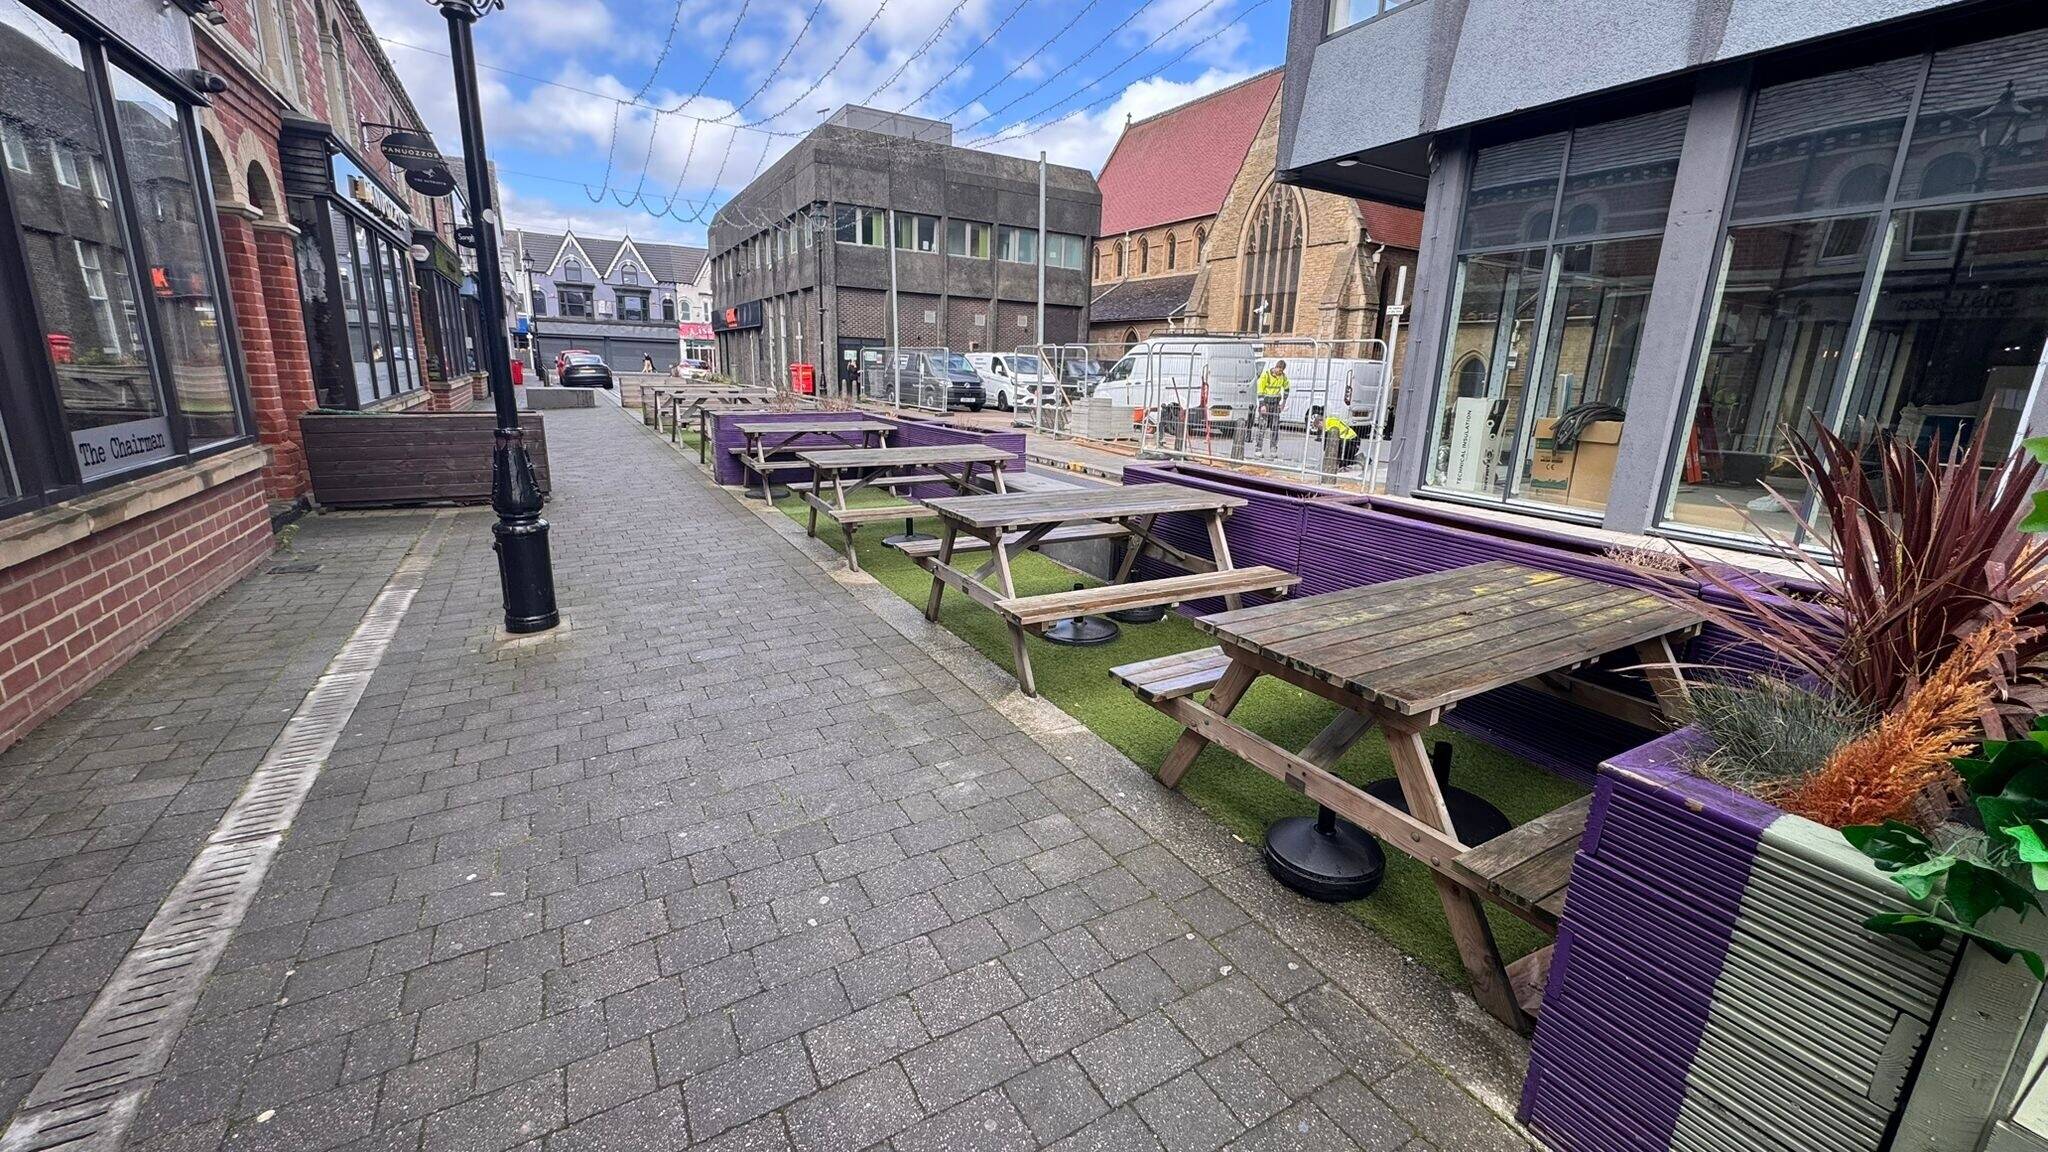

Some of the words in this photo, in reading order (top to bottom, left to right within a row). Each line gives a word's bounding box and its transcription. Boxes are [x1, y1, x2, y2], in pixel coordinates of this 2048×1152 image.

[382, 145, 440, 158] PANUOZZOS
[78, 442, 106, 466] The
[109, 433, 166, 459] Chairman
[1456, 449, 1466, 485] TECHNICAL
[1461, 410, 1472, 449] INSULATION
